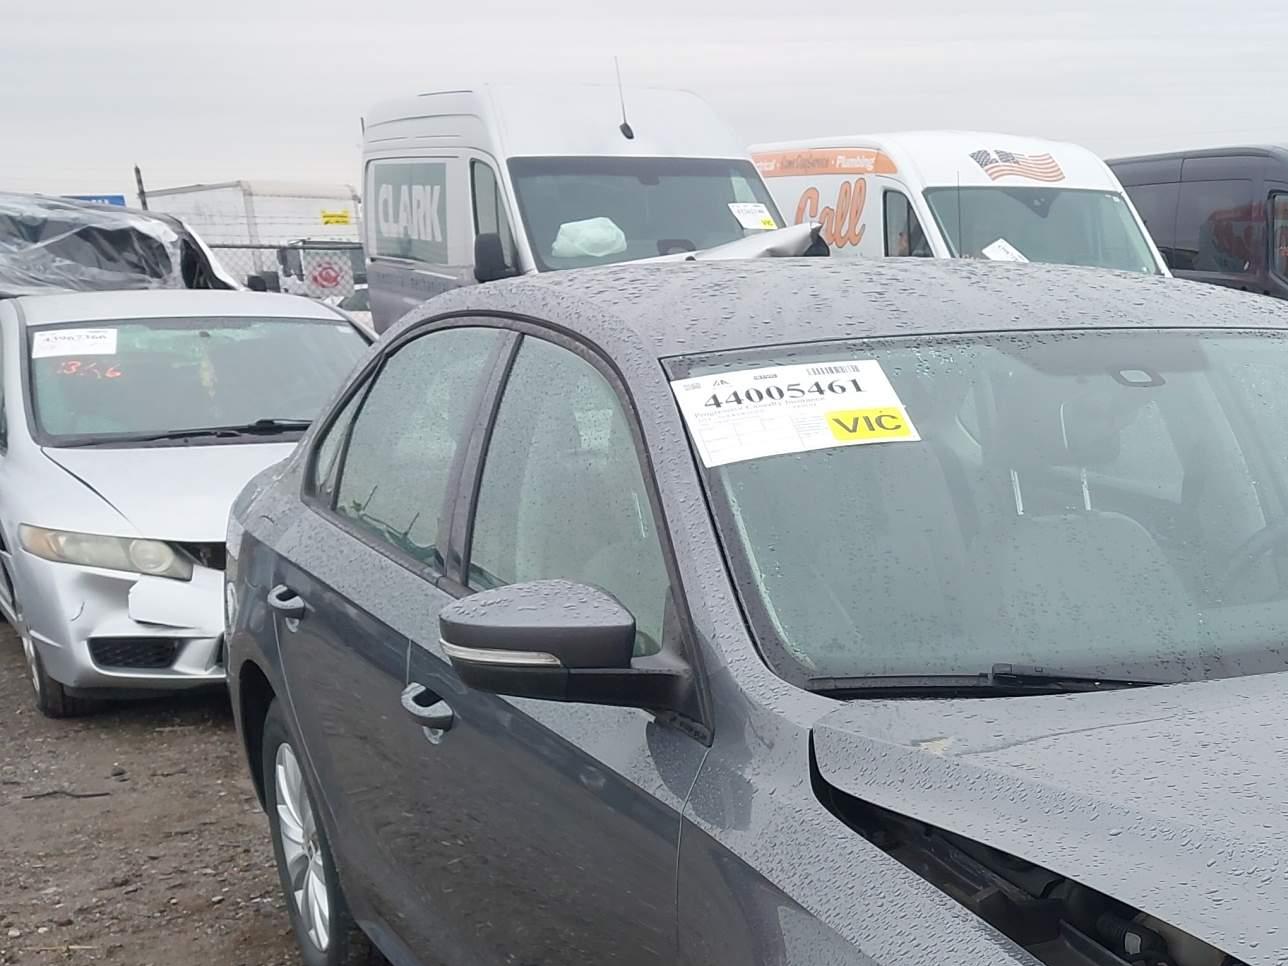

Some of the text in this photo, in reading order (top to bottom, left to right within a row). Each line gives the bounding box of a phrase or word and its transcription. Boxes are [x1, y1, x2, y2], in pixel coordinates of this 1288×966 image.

[378, 183, 442, 242] CLARK
[704, 378, 867, 408] 44005461
[832, 414, 902, 434] VIC
